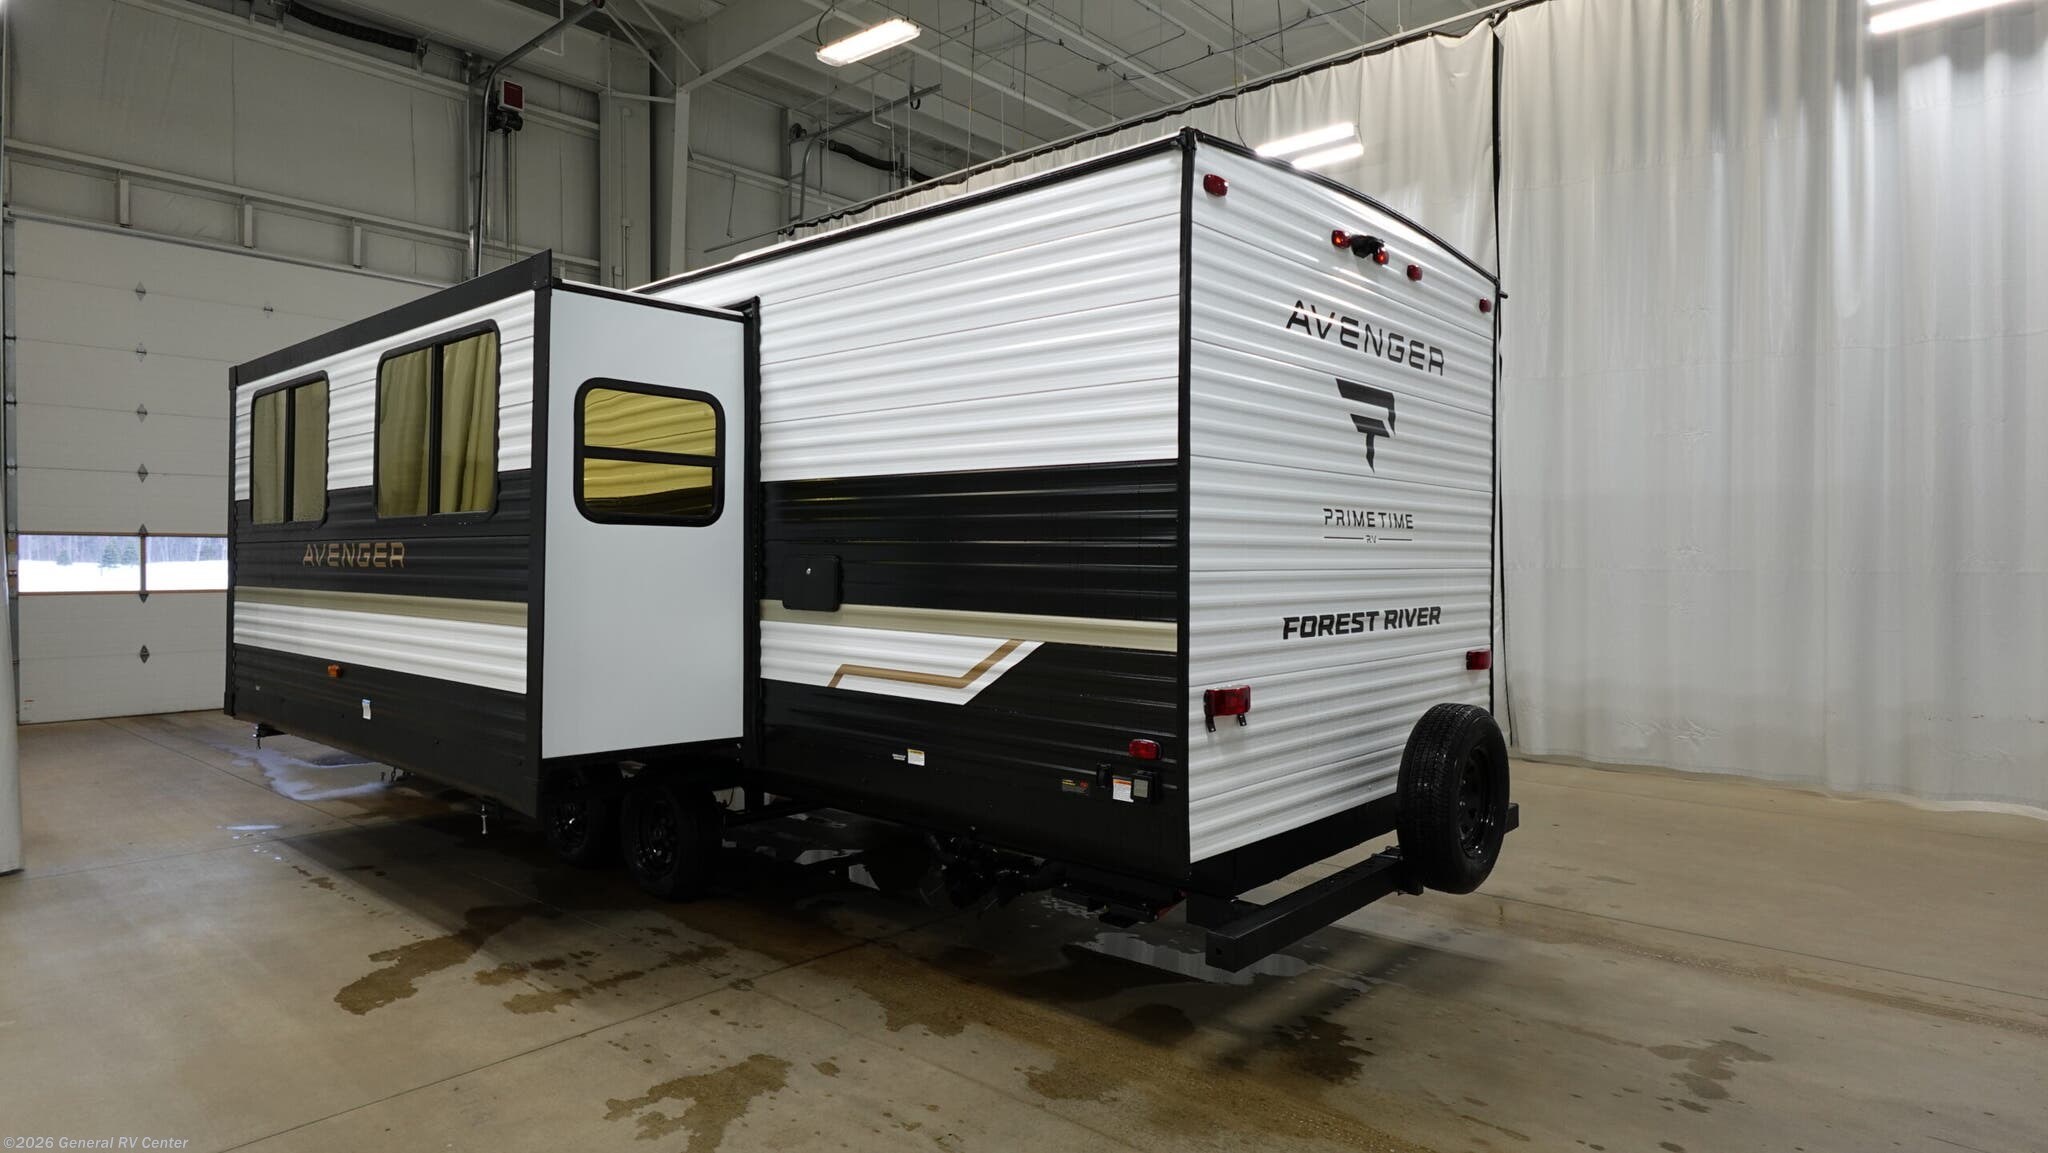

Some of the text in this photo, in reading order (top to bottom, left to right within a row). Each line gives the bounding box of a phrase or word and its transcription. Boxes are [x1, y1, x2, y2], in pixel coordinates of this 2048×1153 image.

[1285, 299, 1445, 376] AVENGER
[1323, 508, 1414, 530] PRIMETIME
[1364, 535, 1378, 544] RV
[302, 541, 406, 568] AVENGER
[1282, 606, 1442, 640] FOREST RIVER
